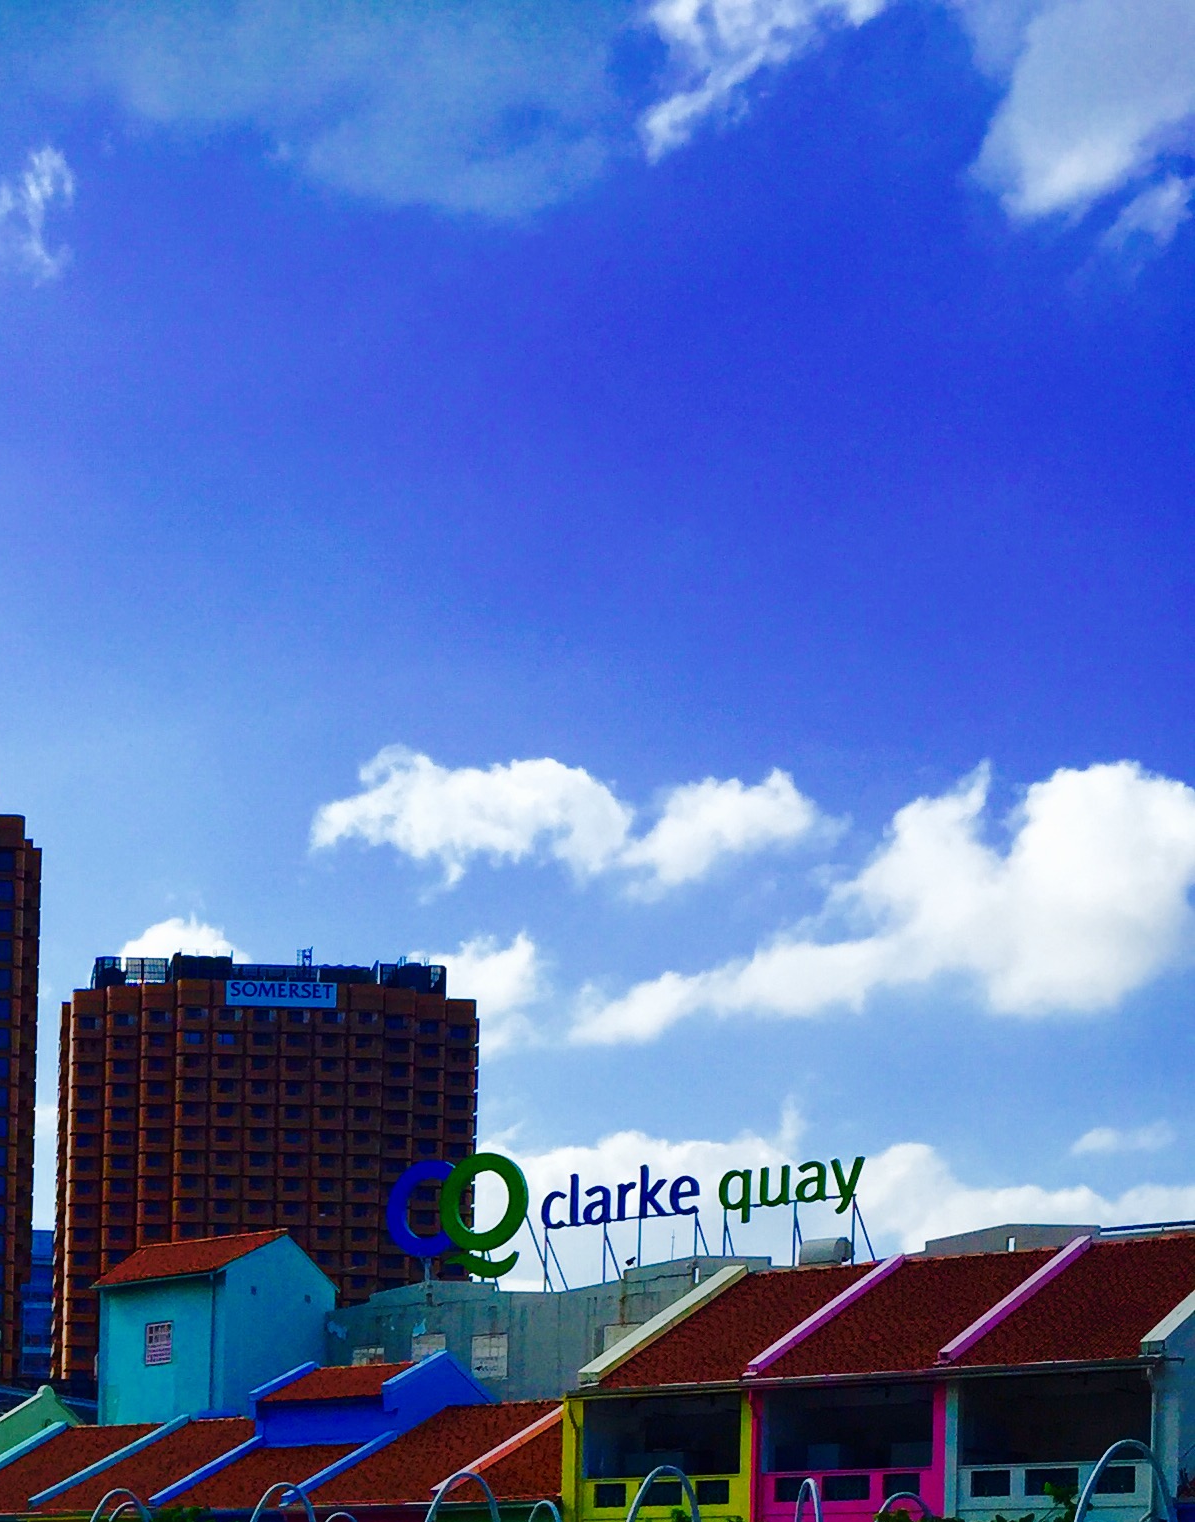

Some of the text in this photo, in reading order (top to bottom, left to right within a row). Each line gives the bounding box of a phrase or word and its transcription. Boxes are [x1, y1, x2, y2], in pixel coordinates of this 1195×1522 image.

[230, 981, 334, 1000] SOMERSET
[386, 1152, 866, 1278] CQ clarke quay
